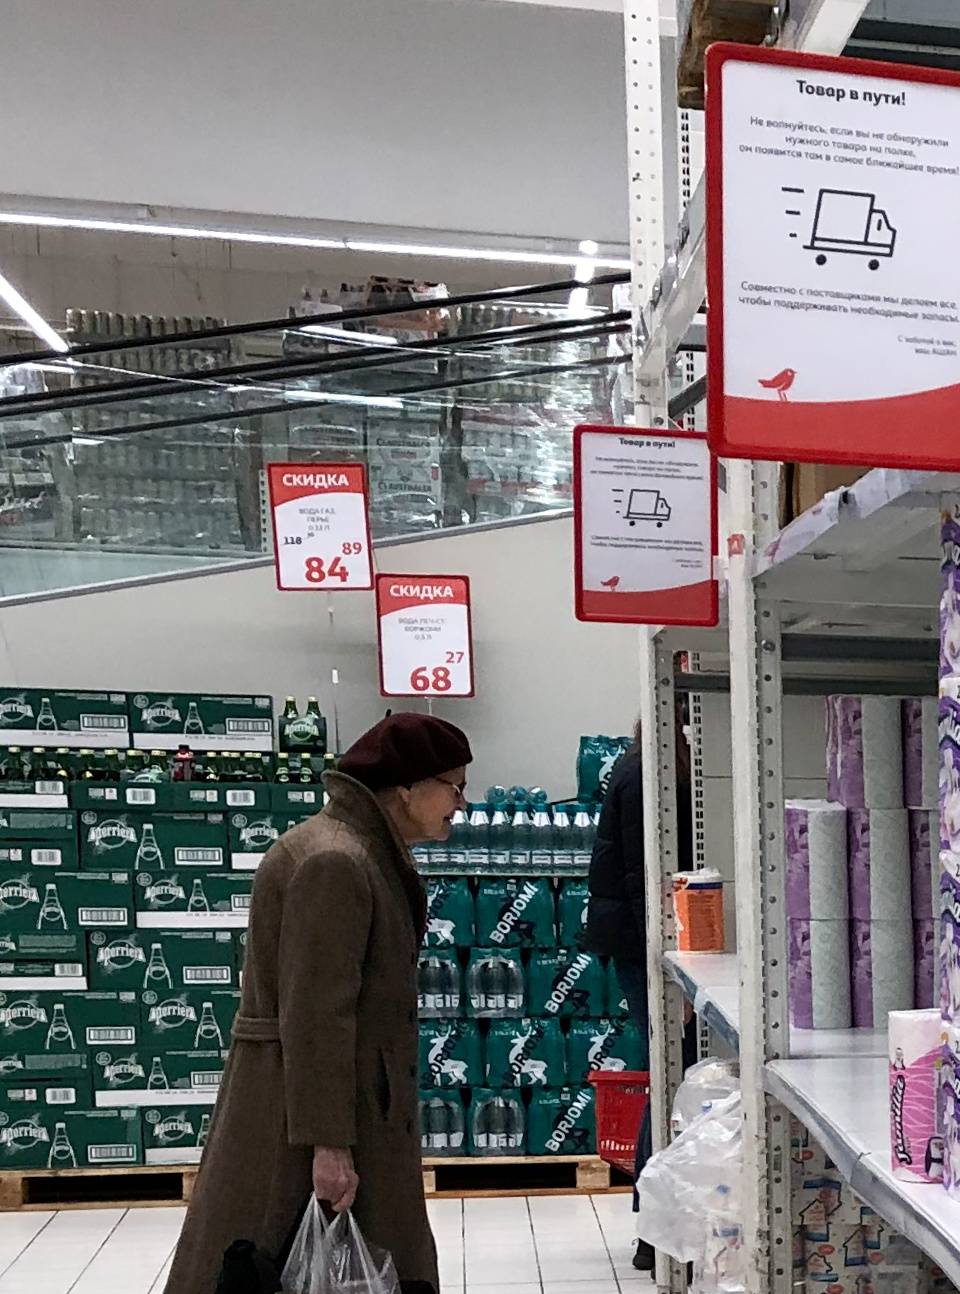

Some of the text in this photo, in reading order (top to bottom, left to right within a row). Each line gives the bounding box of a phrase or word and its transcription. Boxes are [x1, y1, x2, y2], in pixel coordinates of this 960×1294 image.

[796, 79, 907, 107] Товар в пути!
[750, 116, 950, 148] Не волнуйтесь, если вы не обнаружили
[785, 135, 830, 149] нужного
[832, 140, 867, 153] товара
[870, 144, 882, 153] на
[739, 144, 753, 154] он
[755, 145, 802, 159] появится
[804, 150, 822, 161] там
[833, 154, 864, 166] самое
[866, 157, 924, 172] ближайшее
[926, 164, 960, 177] время!
[739, 295, 772, 308] чтобы
[774, 299, 849, 314] поддерживать
[850, 304, 919, 320] необходимые
[741, 281, 797, 296] Совместно
[806, 288, 881, 303] поставщиками
[883, 295, 899, 305] мы
[901, 297, 938, 310] делаем
[619, 437, 645, 448] Товар
[653, 440, 676, 449] пути!
[282, 473, 350, 489] СКИДКА
[342, 542, 362, 555] 89
[305, 556, 349, 582] 84
[390, 585, 454, 600] СКИДКА
[446, 651, 464, 664] 27
[410, 666, 452, 691] 68
[489, 881, 538, 944] BORJOMI
[544, 953, 592, 1014] BORJOMI
[544, 1092, 592, 1152] BORJOMI
